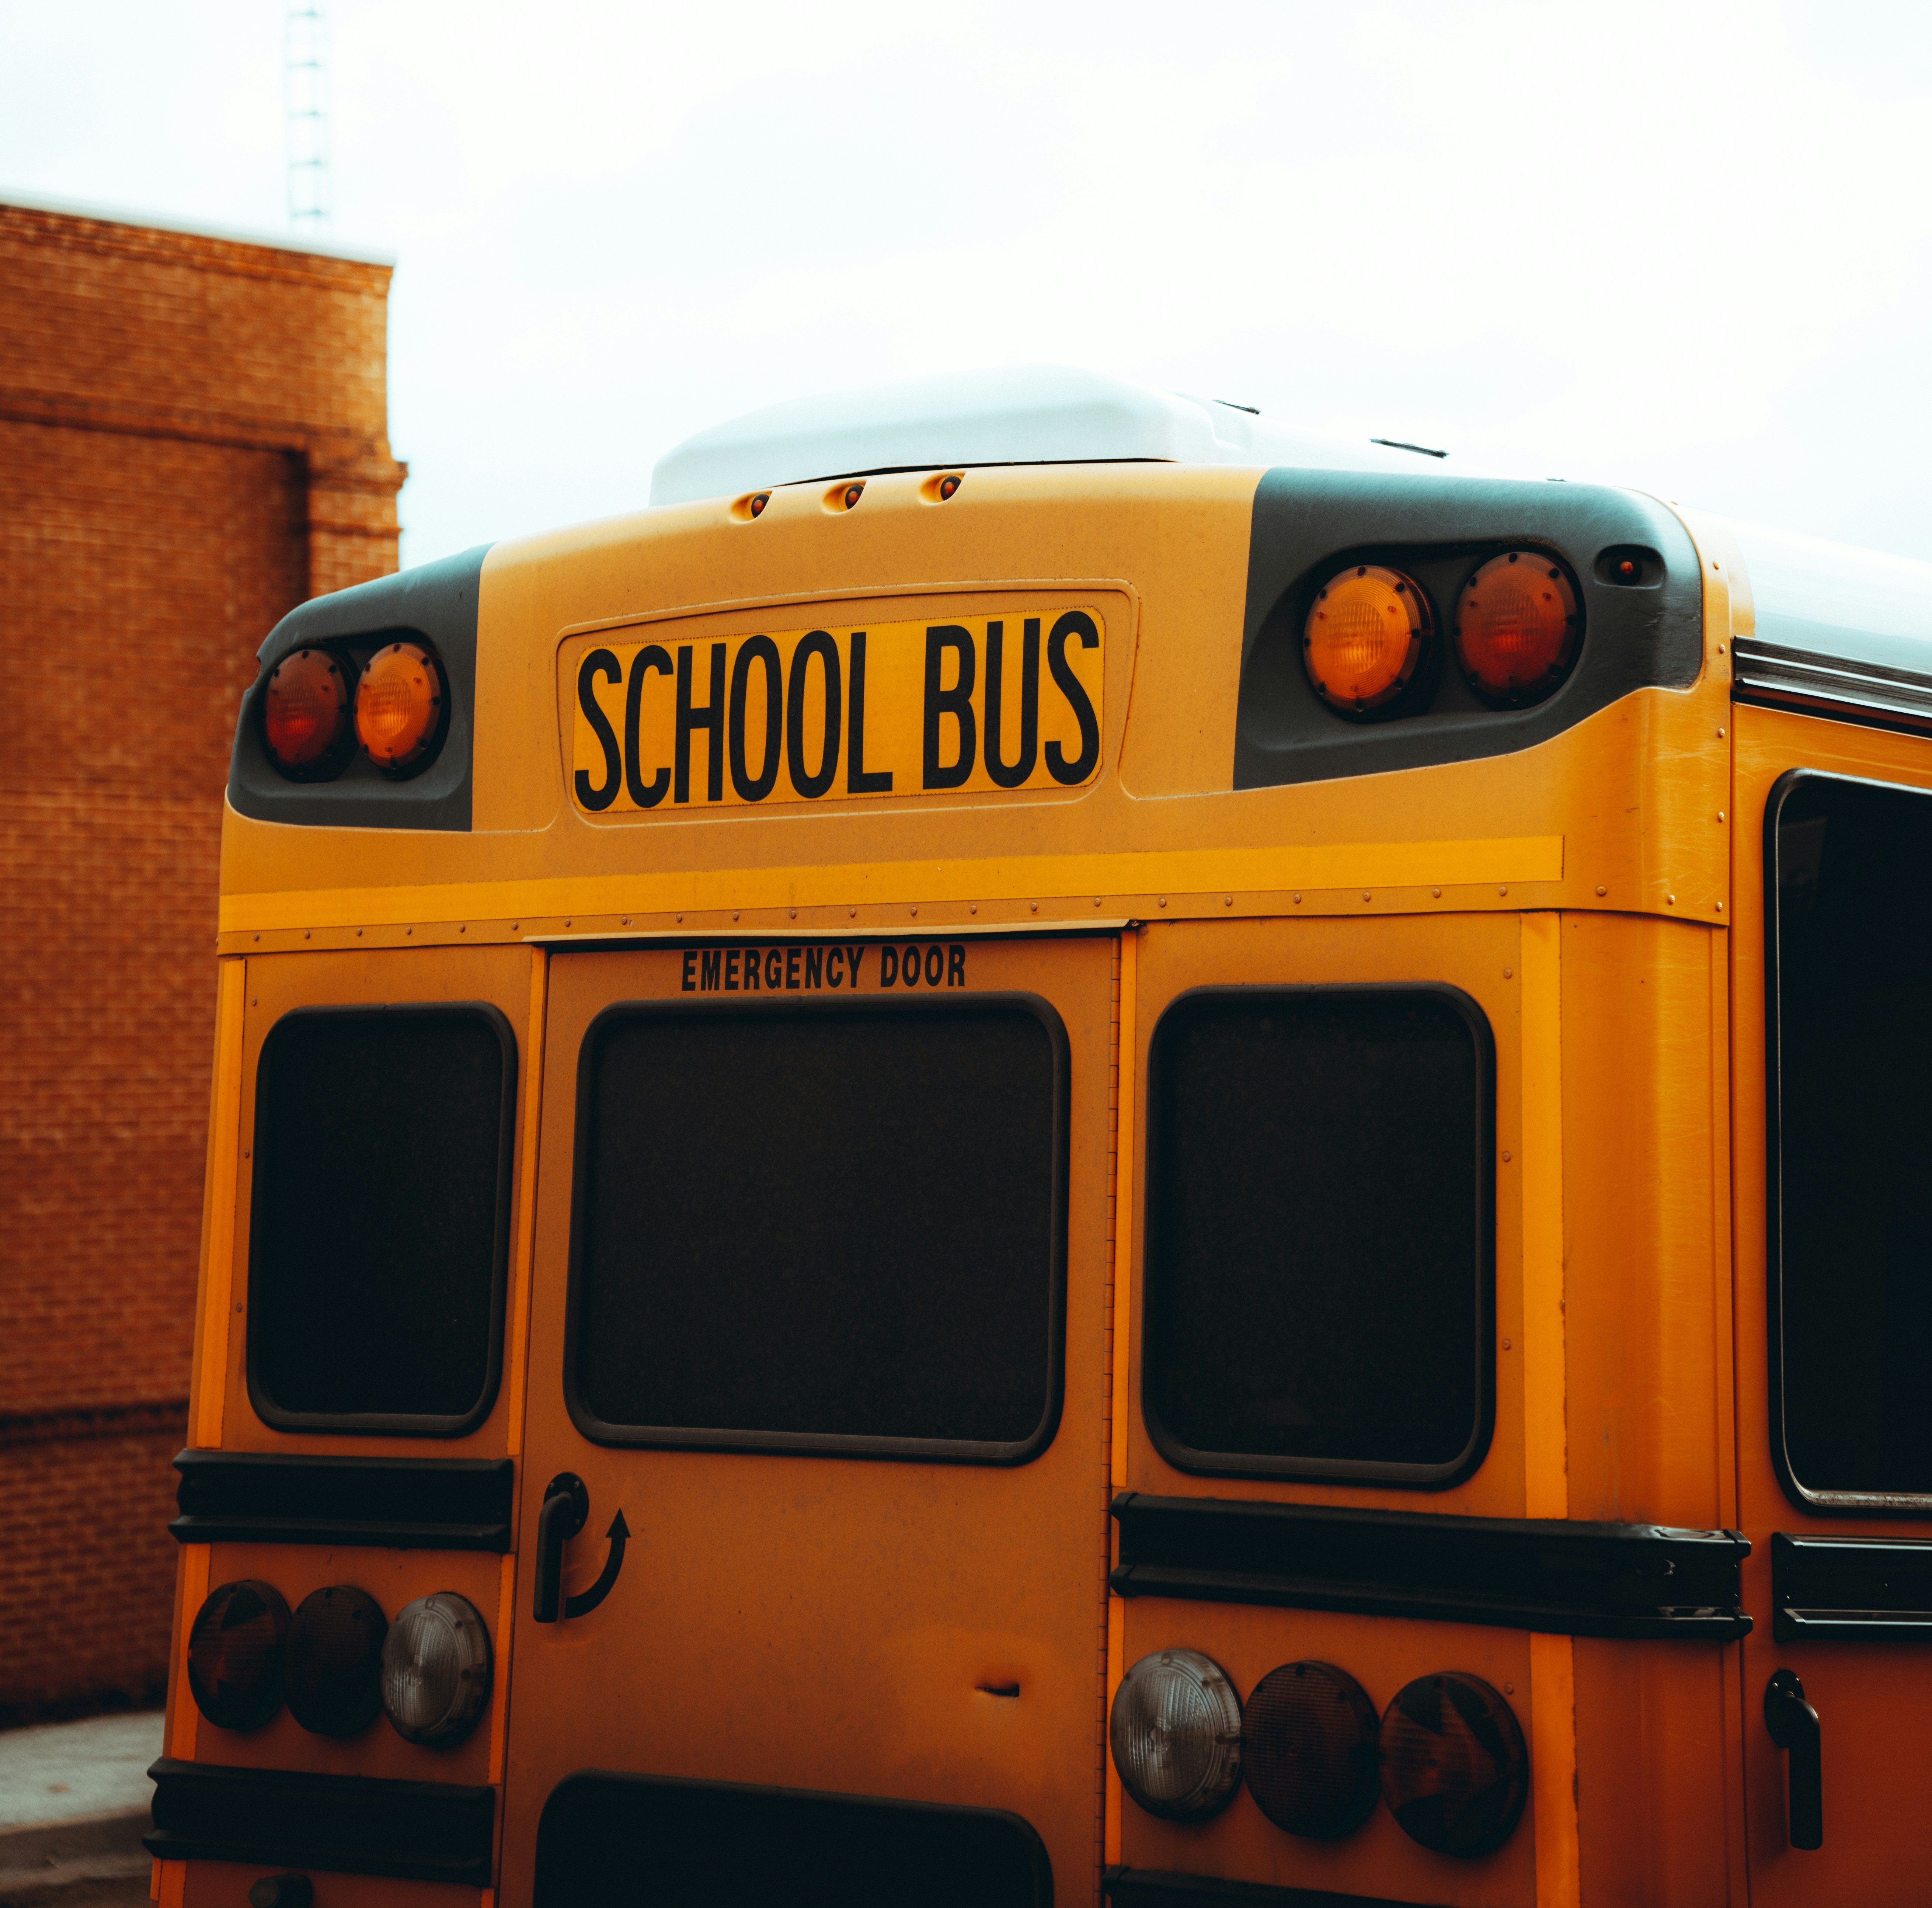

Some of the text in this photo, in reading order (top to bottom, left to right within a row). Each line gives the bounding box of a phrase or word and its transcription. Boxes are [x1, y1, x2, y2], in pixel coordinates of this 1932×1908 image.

[574, 611, 1100, 811] SCHOOL BUS
[682, 945, 965, 991] EMERGENCY DOOR
